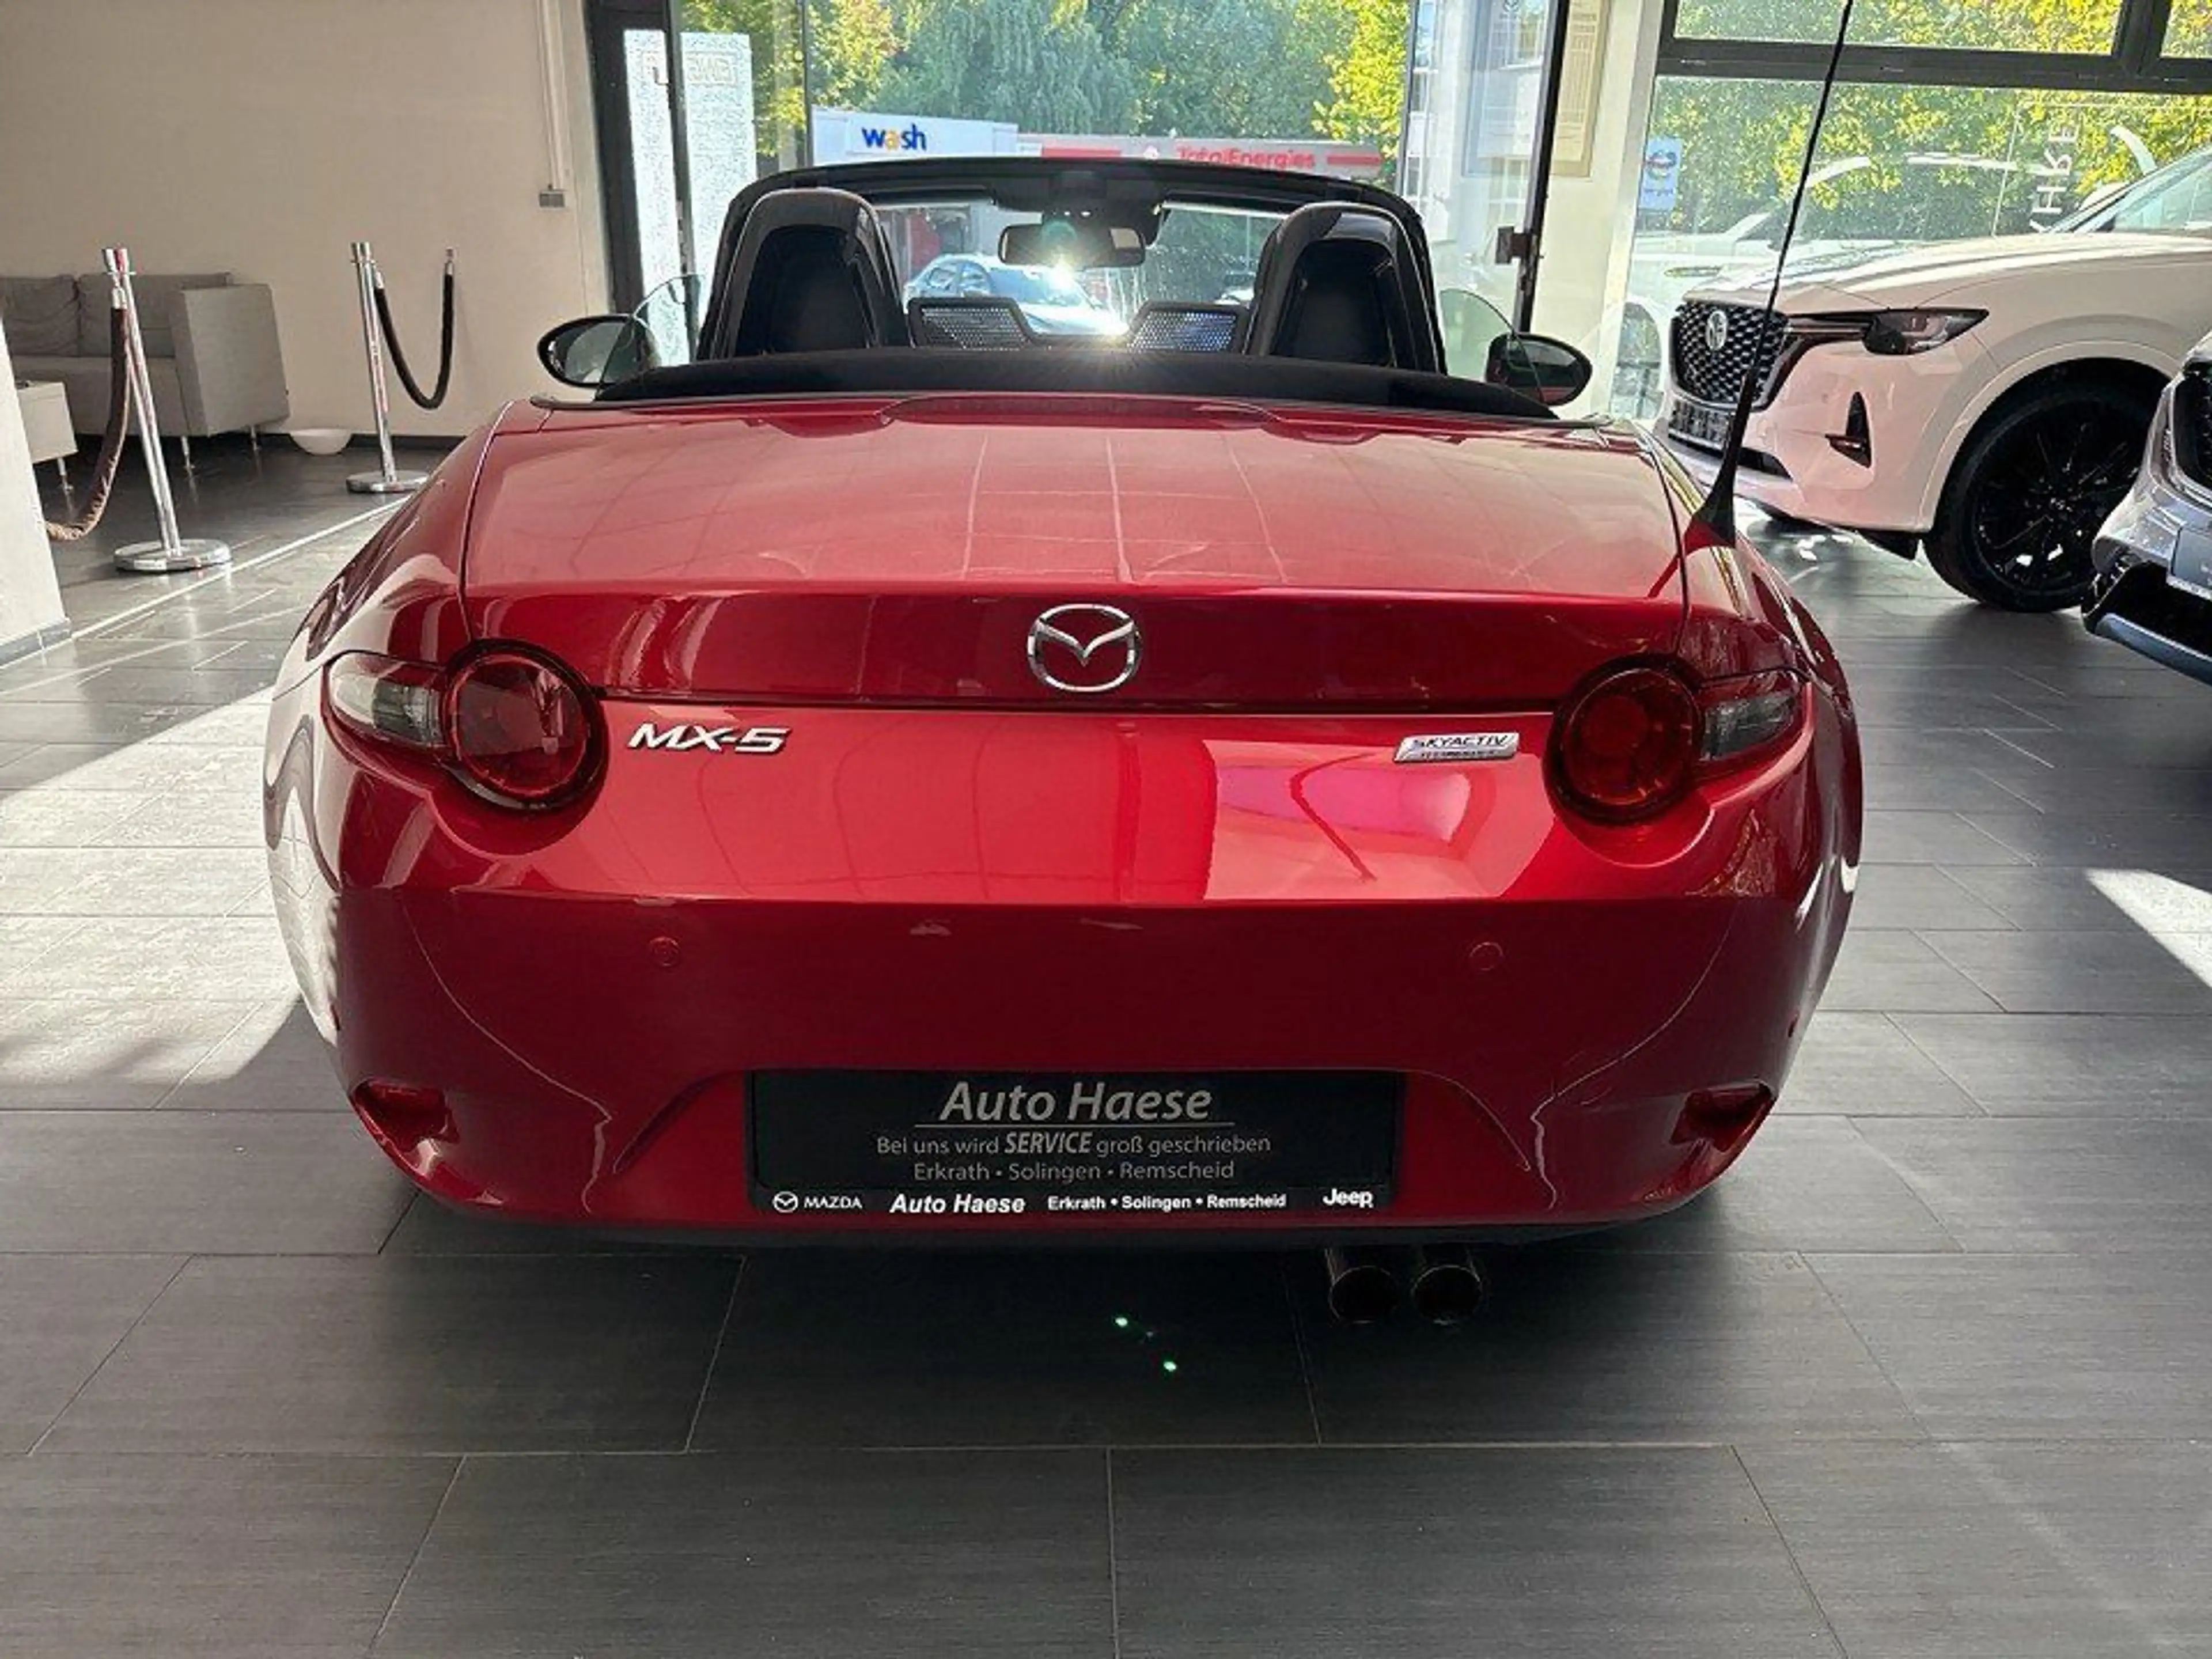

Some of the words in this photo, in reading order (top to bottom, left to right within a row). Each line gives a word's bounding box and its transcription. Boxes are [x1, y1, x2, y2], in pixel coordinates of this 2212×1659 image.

[861, 122, 927, 150] wash
[627, 721, 792, 754] MX-5
[939, 1082, 1055, 1120] Auto
[1067, 1082, 1213, 1120] Haese
[877, 1137, 907, 1154] Bei
[914, 1138, 950, 1153] uns
[955, 1137, 999, 1153] wird
[1005, 1131, 1093, 1154] SERVICE
[1096, 1135, 1143, 1158] groß
[1148, 1135, 1271, 1157] geschrieben
[914, 1162, 990, 1181] Erkrath
[1009, 1162, 1101, 1184] Solingen
[1119, 1160, 1234, 1179] Remscheid
[804, 1196, 863, 1209] MAZDA
[889, 1194, 946, 1214] Auto
[953, 1193, 1027, 1213] Haese
[1048, 1196, 1105, 1209] Erkrath
[1122, 1195, 1191, 1213] Solingen
[1207, 1194, 1286, 1209] Remscheid
[1322, 1188, 1374, 1209] Jeep
